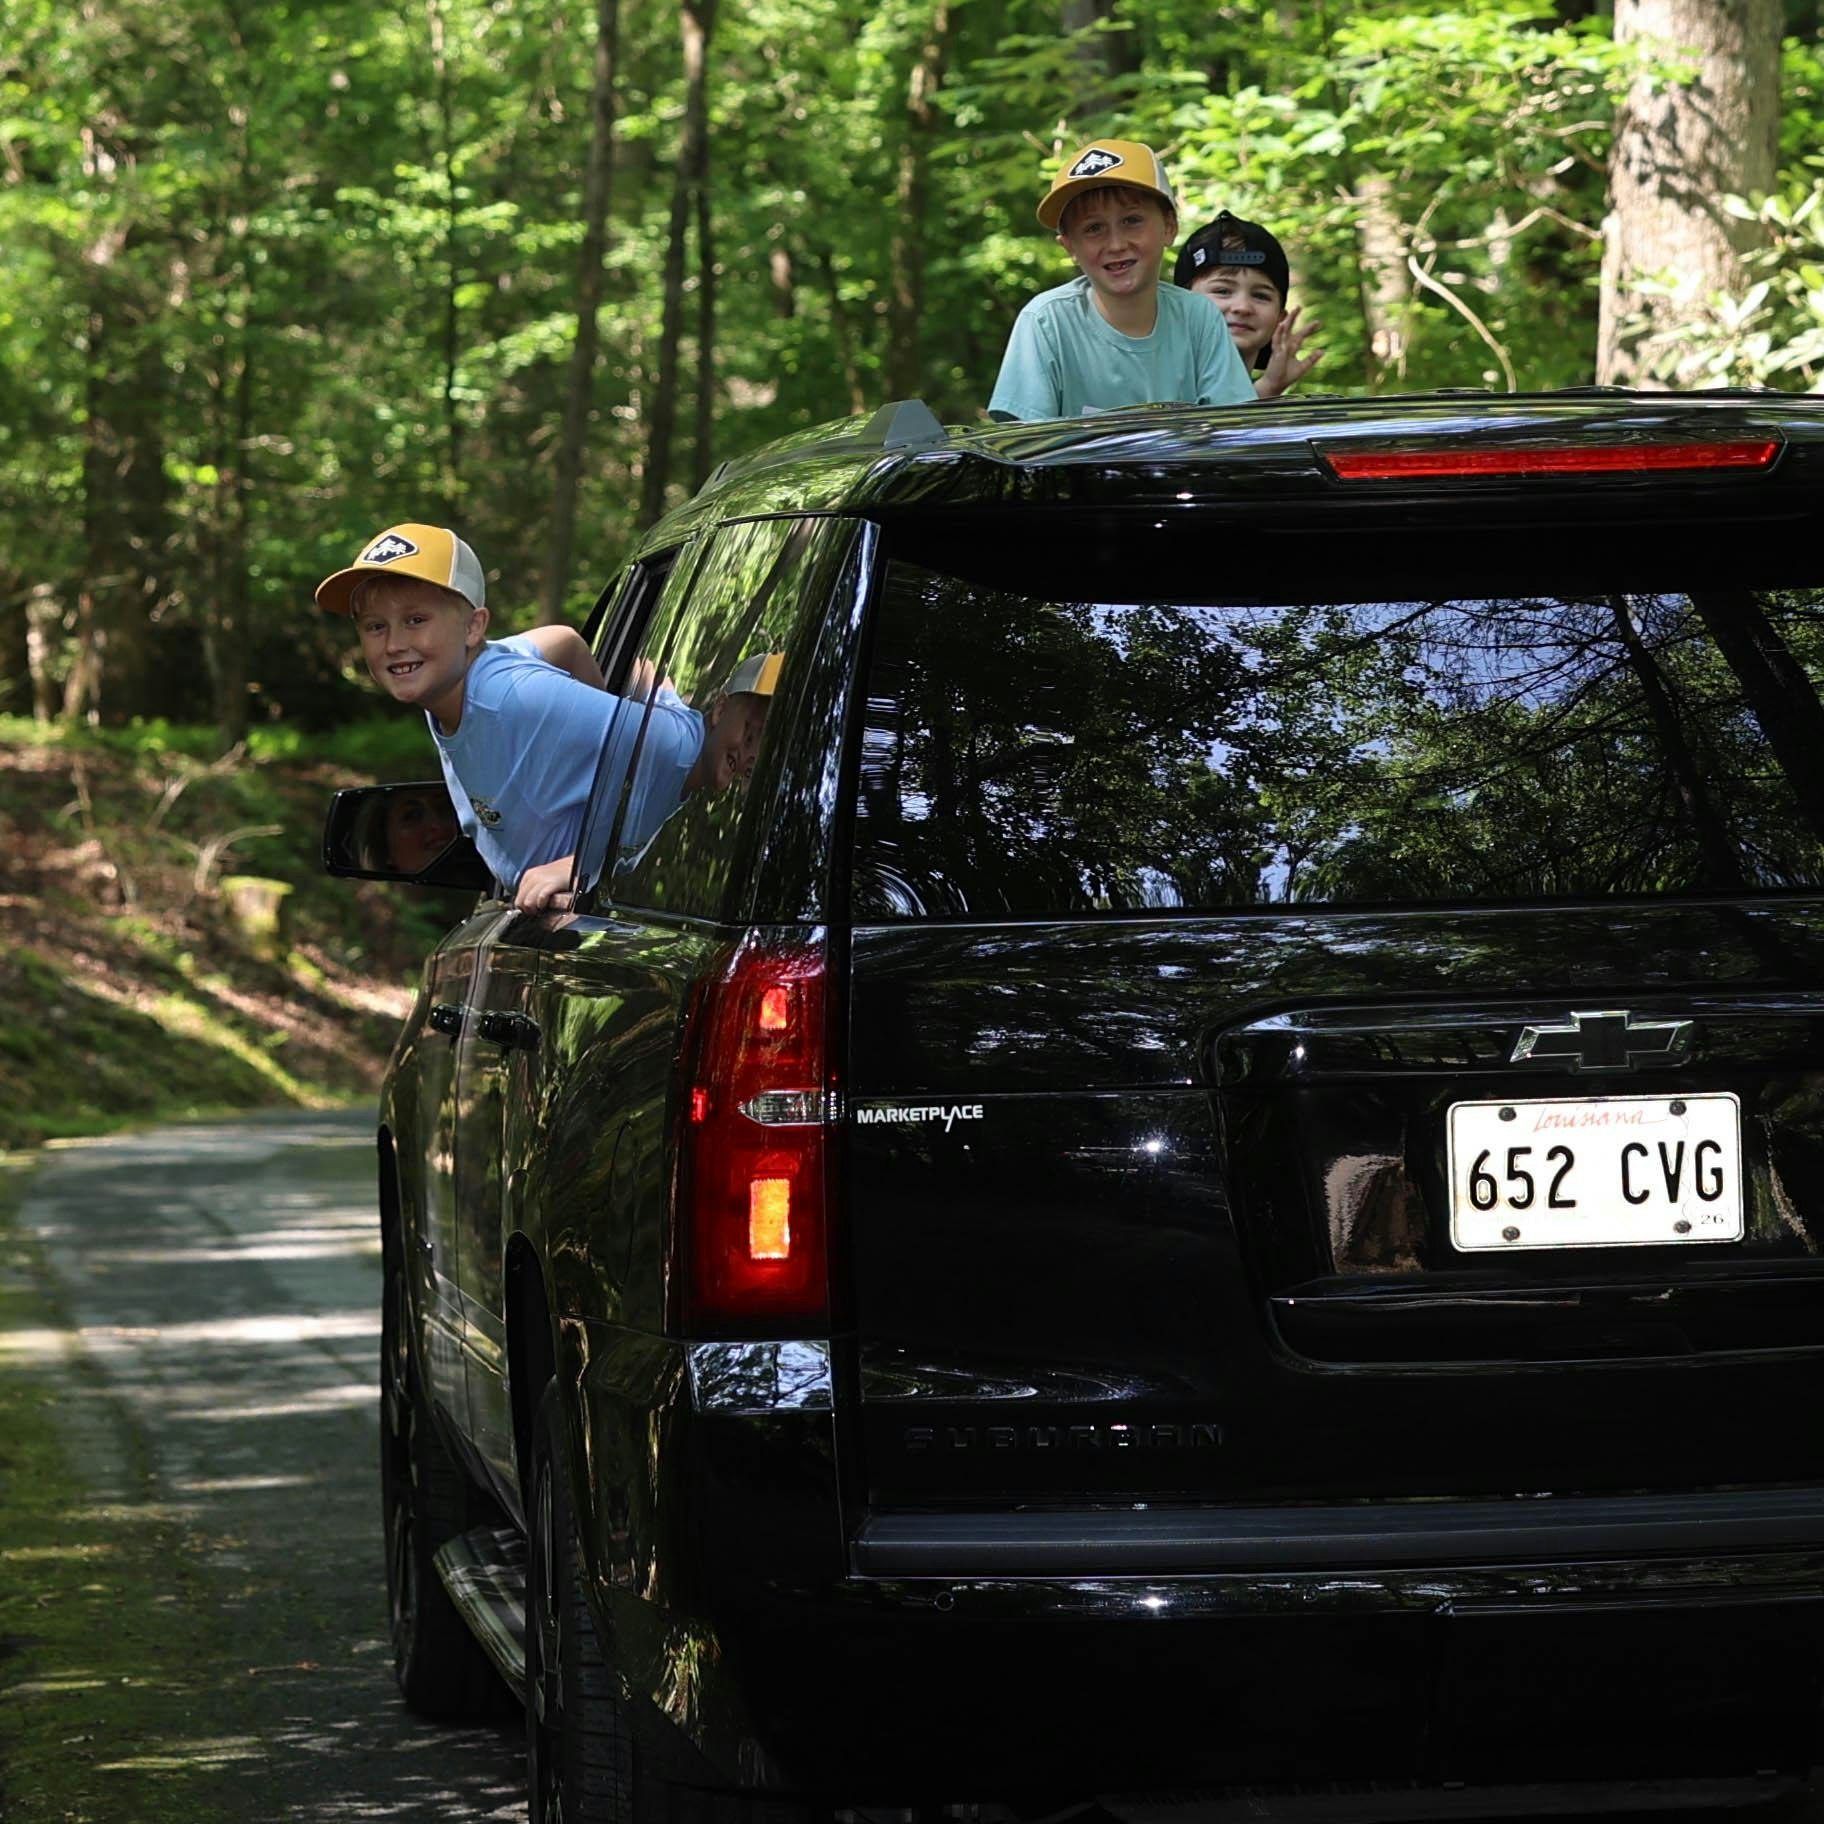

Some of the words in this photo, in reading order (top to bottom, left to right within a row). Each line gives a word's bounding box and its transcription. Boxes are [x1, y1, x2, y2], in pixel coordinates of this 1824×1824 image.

[856, 1103, 984, 1132] MARKETPLACE
[1533, 1103, 1660, 1132] Louisiana
[1469, 1144, 1578, 1211] 652
[1621, 1139, 1723, 1205] CVG
[905, 1423, 1225, 1449] SUBURBAN
